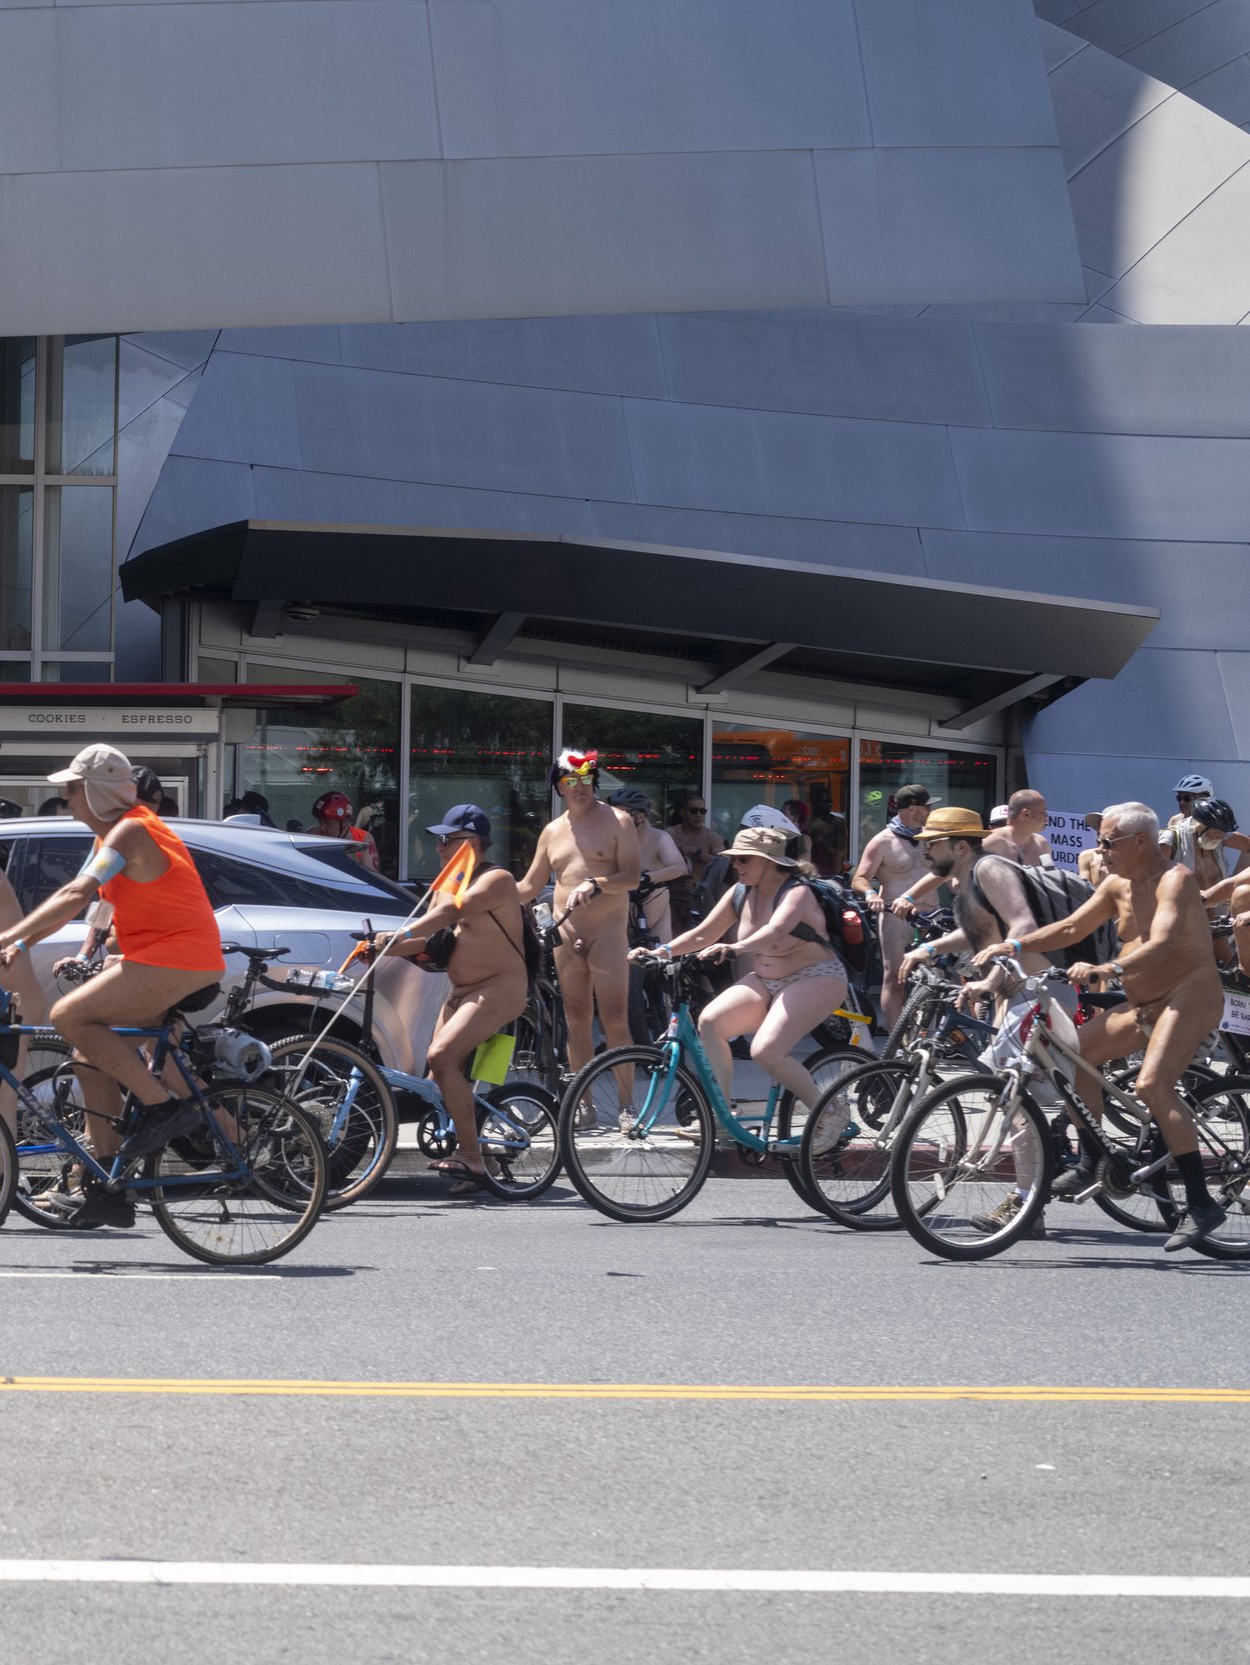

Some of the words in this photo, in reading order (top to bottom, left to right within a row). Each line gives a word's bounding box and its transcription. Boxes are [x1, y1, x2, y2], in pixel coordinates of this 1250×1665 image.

[28, 714, 86, 723] COOKIES
[121, 715, 193, 724] ESPRESSO
[1050, 833, 1083, 848] MASS
[1063, 1083, 1118, 1154] SCHWINN
